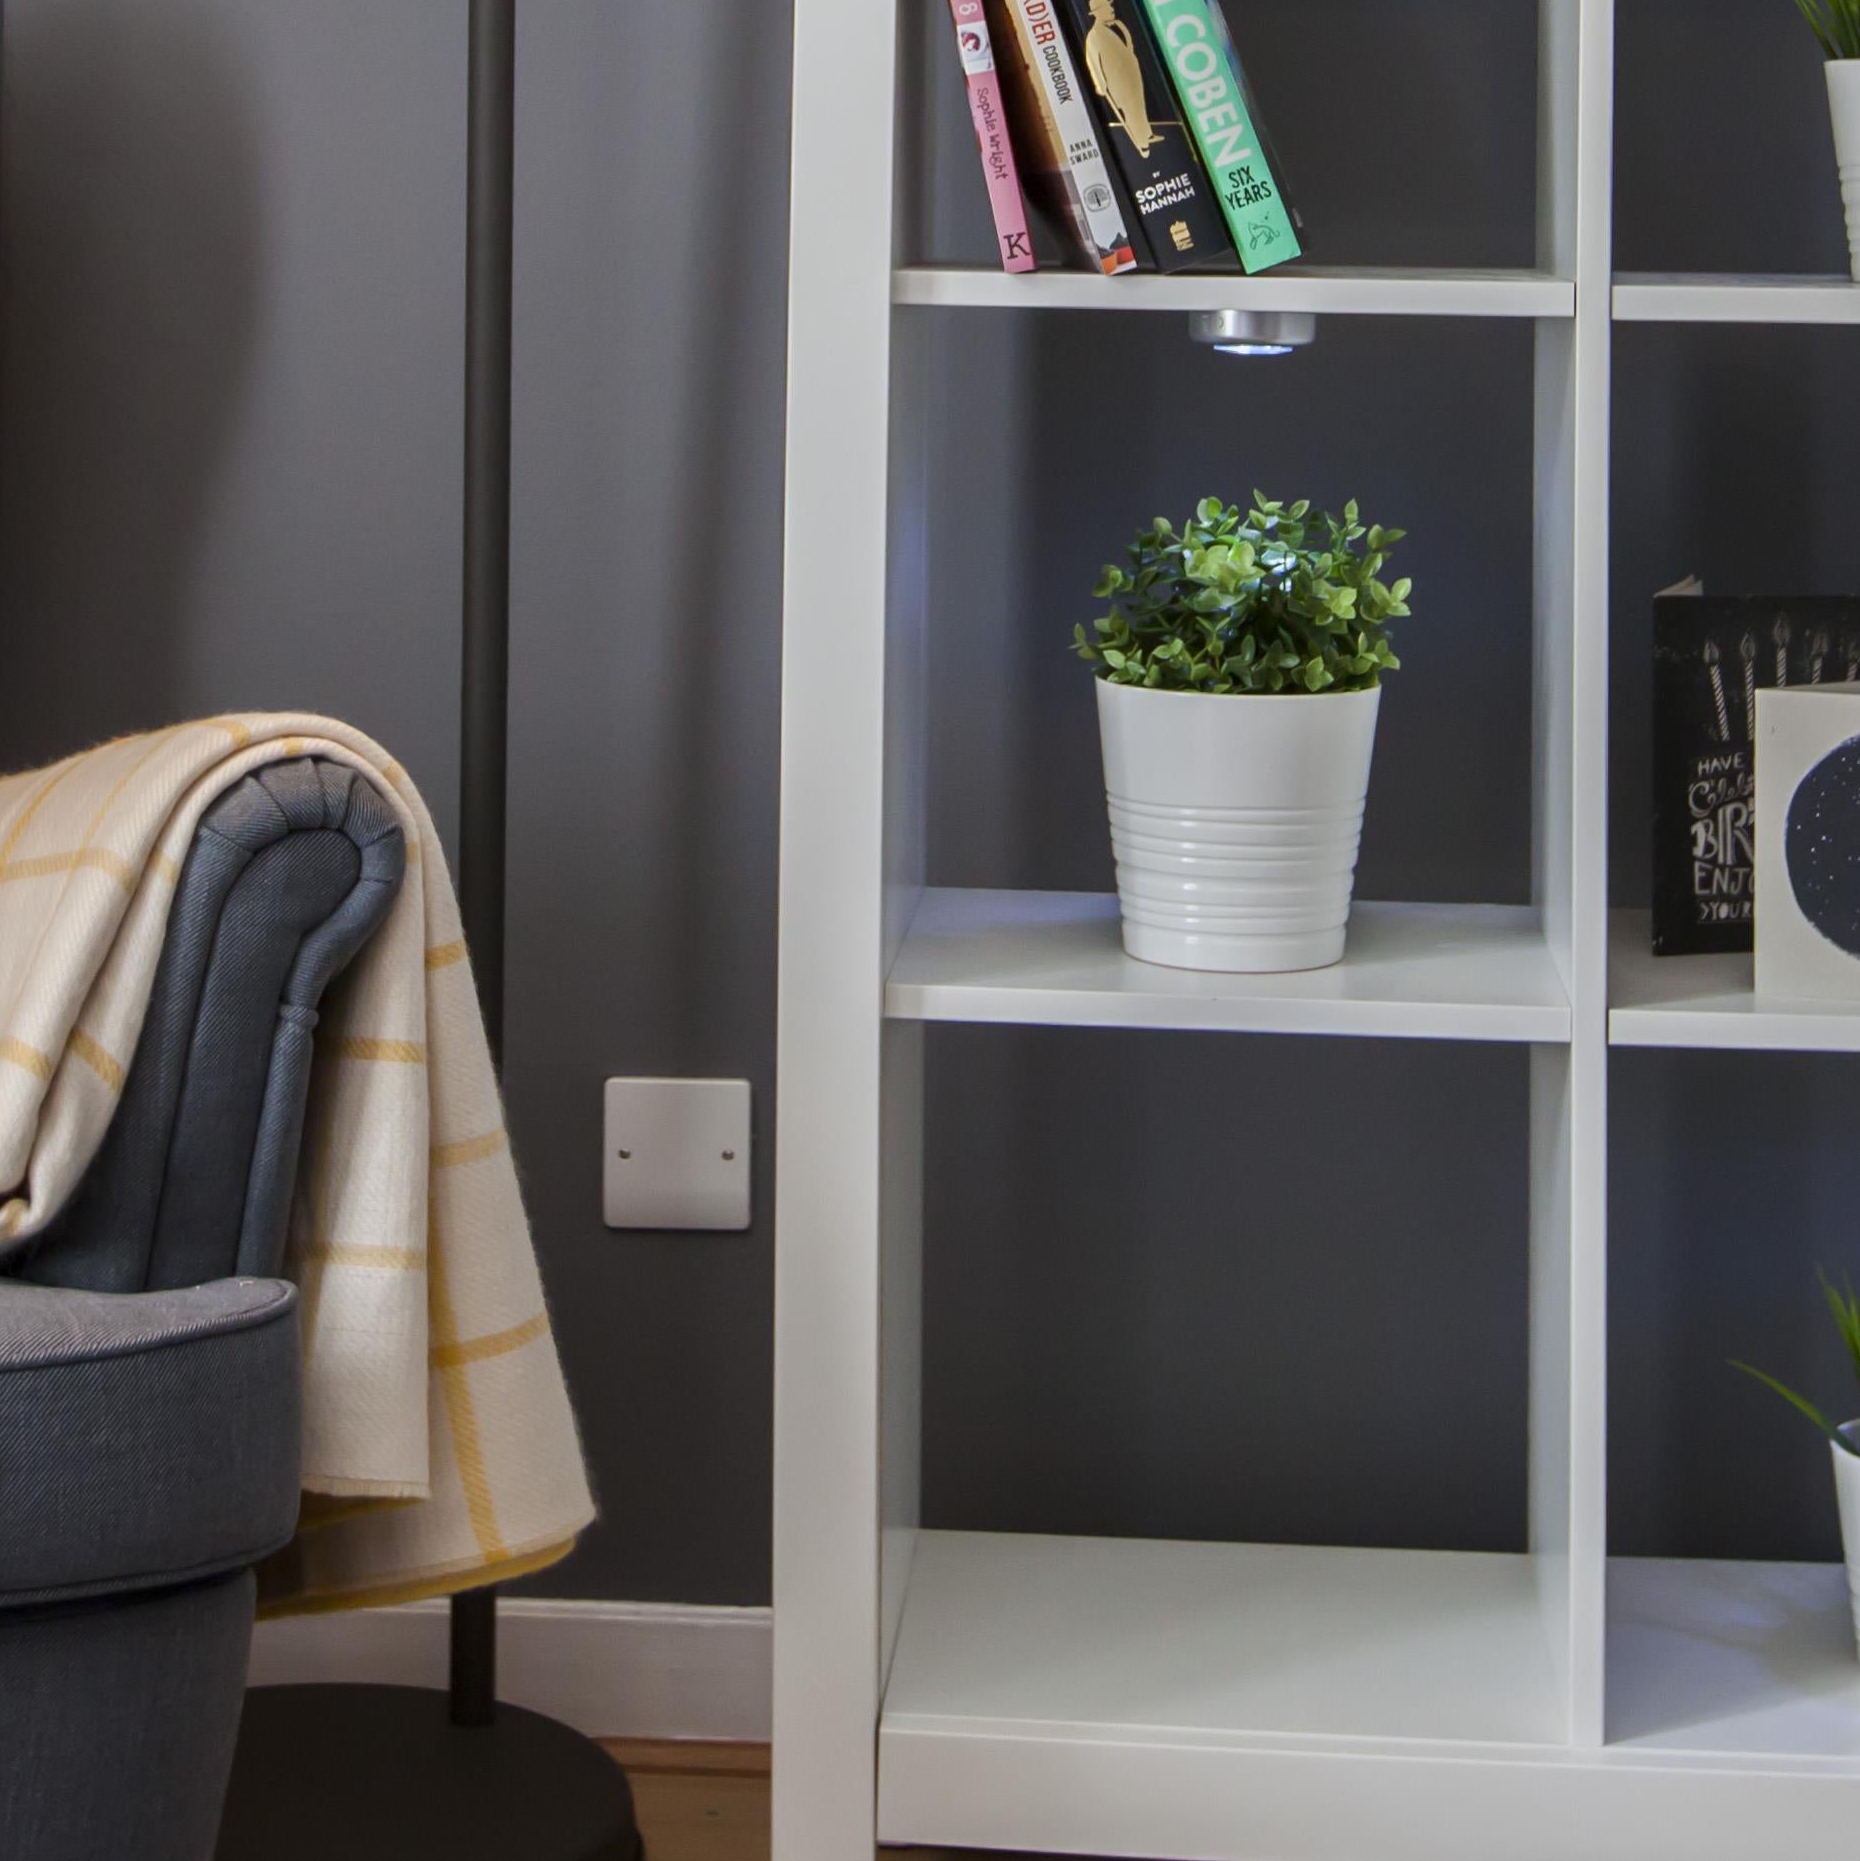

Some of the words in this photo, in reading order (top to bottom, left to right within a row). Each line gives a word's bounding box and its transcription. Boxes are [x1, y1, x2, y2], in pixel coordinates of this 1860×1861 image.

[959, 2, 978, 16] 8
[1042, 44, 1073, 105] COOKBOOK
[1166, 14, 1251, 168] COBEN
[977, 87, 998, 133] Sophie
[1069, 139, 1094, 154] ANNA
[1069, 149, 1100, 166] SWARD
[1135, 173, 1191, 204] SOPHIE
[1228, 165, 1256, 189] SIX
[1139, 186, 1196, 215] HANNAH
[1224, 181, 1272, 210] YEARS
[1003, 231, 1032, 260] K
[1698, 752, 1745, 776] HAVE
[1691, 802, 1754, 866] BIR
